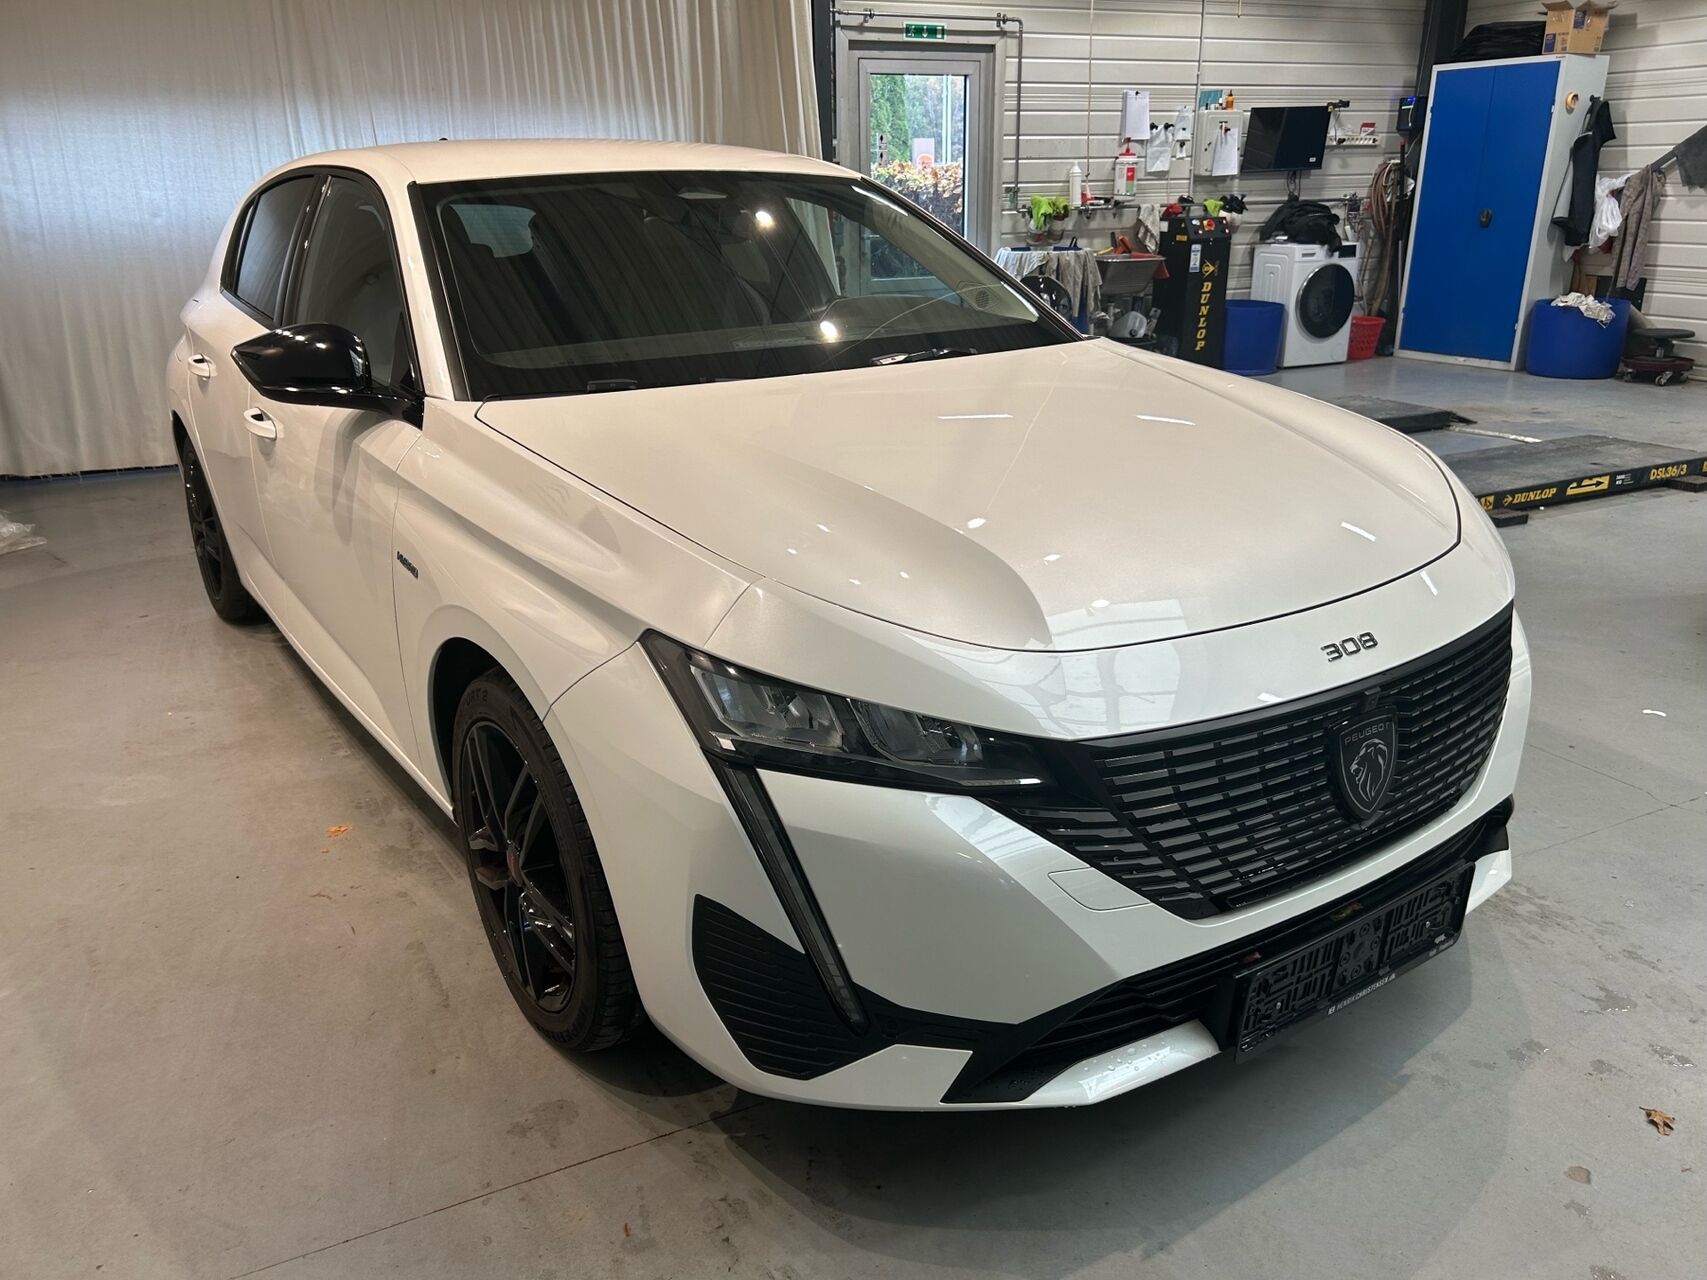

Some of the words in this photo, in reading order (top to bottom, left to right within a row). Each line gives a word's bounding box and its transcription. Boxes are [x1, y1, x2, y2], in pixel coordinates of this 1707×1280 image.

[1195, 282, 1212, 350] DUNLOP
[1649, 464, 1688, 480] DSL36/3
[1512, 487, 1557, 503] DUNLOP
[1320, 631, 1378, 662] 308
[1344, 721, 1390, 744] PEUGEOT
